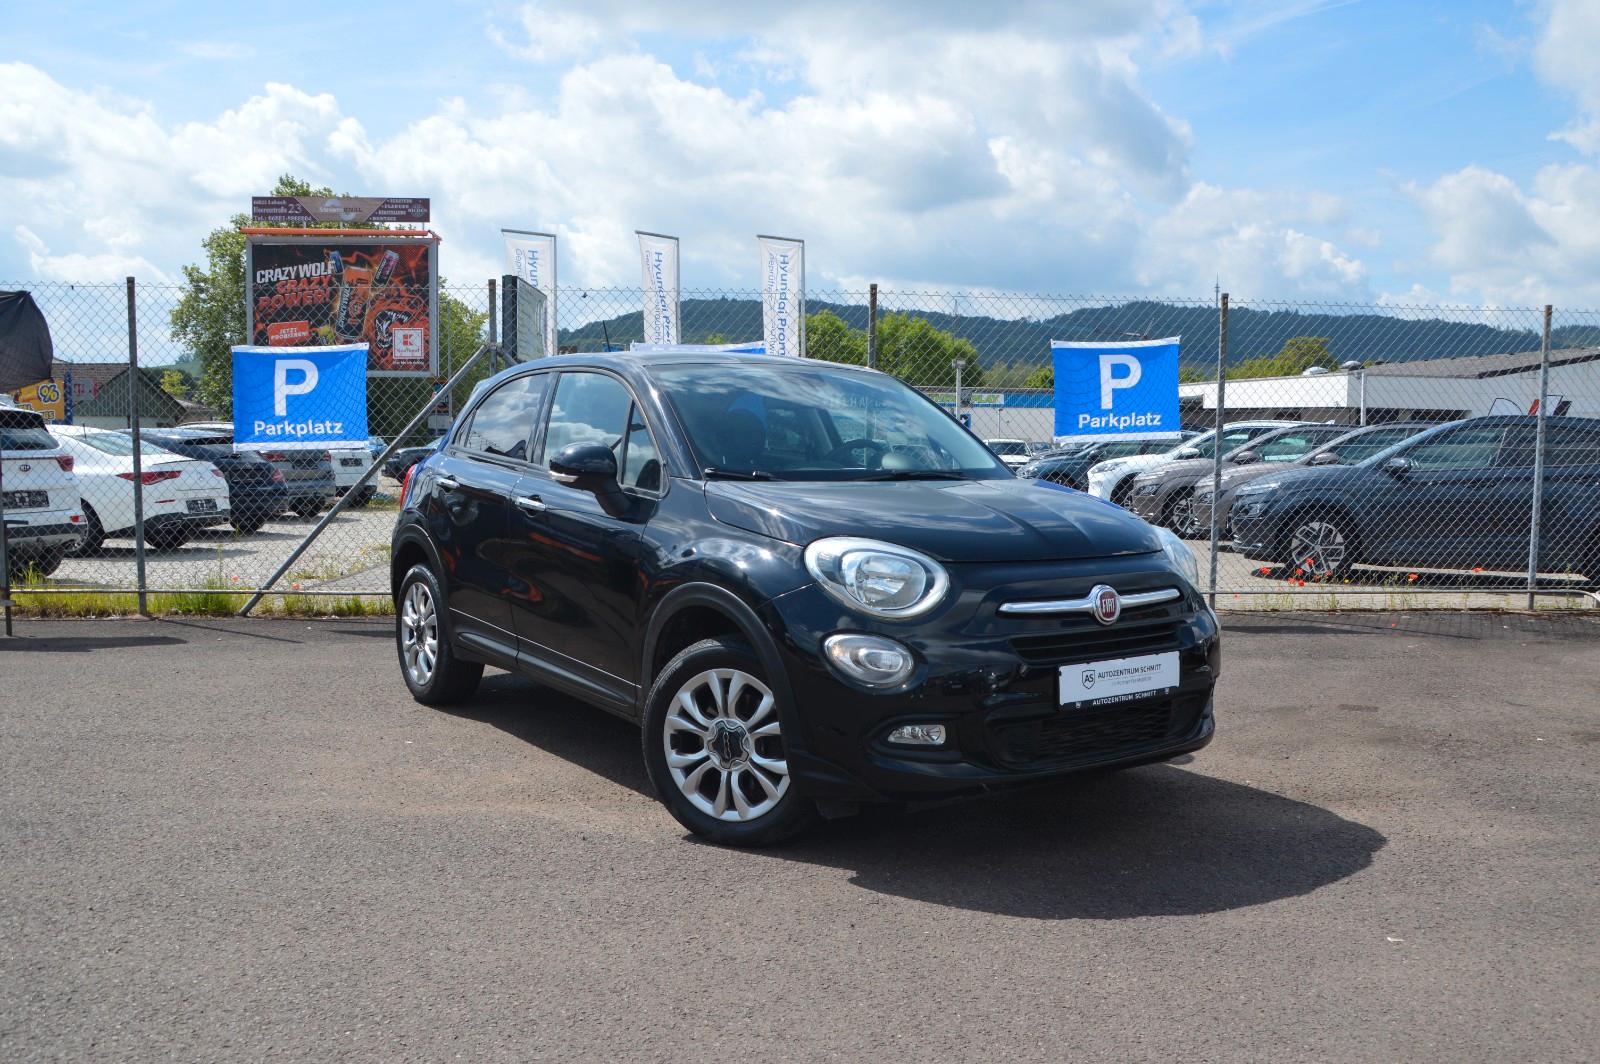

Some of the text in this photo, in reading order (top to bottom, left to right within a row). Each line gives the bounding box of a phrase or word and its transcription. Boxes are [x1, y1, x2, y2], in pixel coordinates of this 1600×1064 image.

[256, 260, 336, 284] CRAZY WOLF
[654, 251, 669, 312] Hyundai
[275, 275, 333, 294] CRAZY
[778, 254, 790, 314] Hyundai
[258, 288, 331, 312] POWER!
[274, 359, 319, 417] P
[1099, 354, 1142, 410] P
[254, 419, 344, 437] Parkplatz
[1078, 412, 1162, 429] Parkplatz
[1101, 597, 1115, 613] FIAT
[1084, 672, 1094, 683] AS
[1097, 663, 1162, 679] AUTOZENTRUM SCHMITT
[1092, 690, 1157, 706] AUTOZENTRUM SCHMITT
